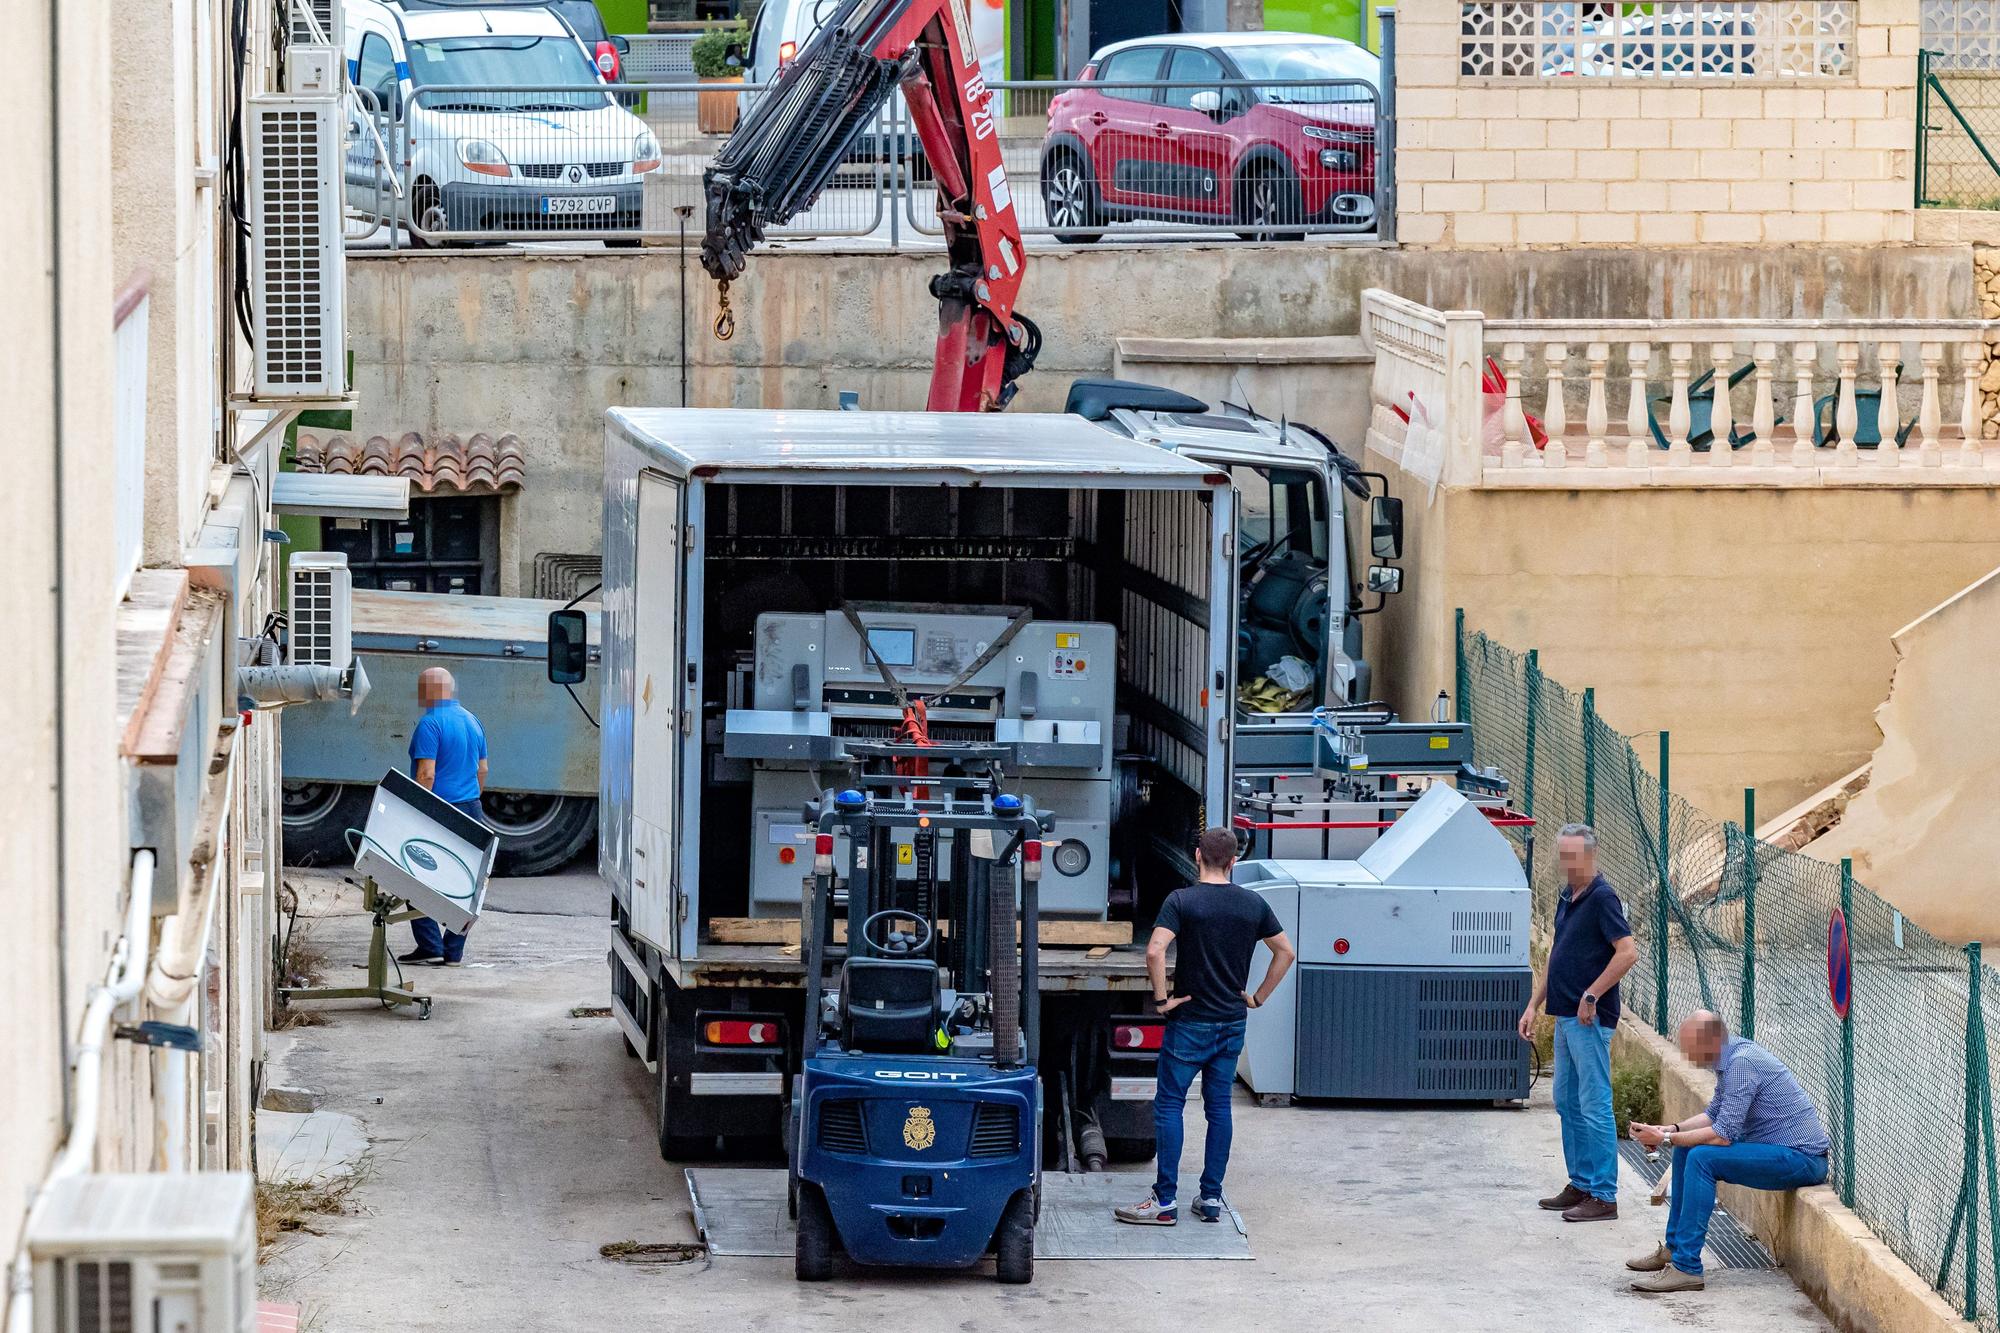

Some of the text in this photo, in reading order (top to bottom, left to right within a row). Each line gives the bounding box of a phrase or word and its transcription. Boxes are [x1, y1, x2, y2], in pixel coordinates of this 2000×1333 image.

[964, 71, 995, 140] 18 20
[551, 198, 612, 212] 5792 CVP
[874, 1070, 967, 1080] GOIT
